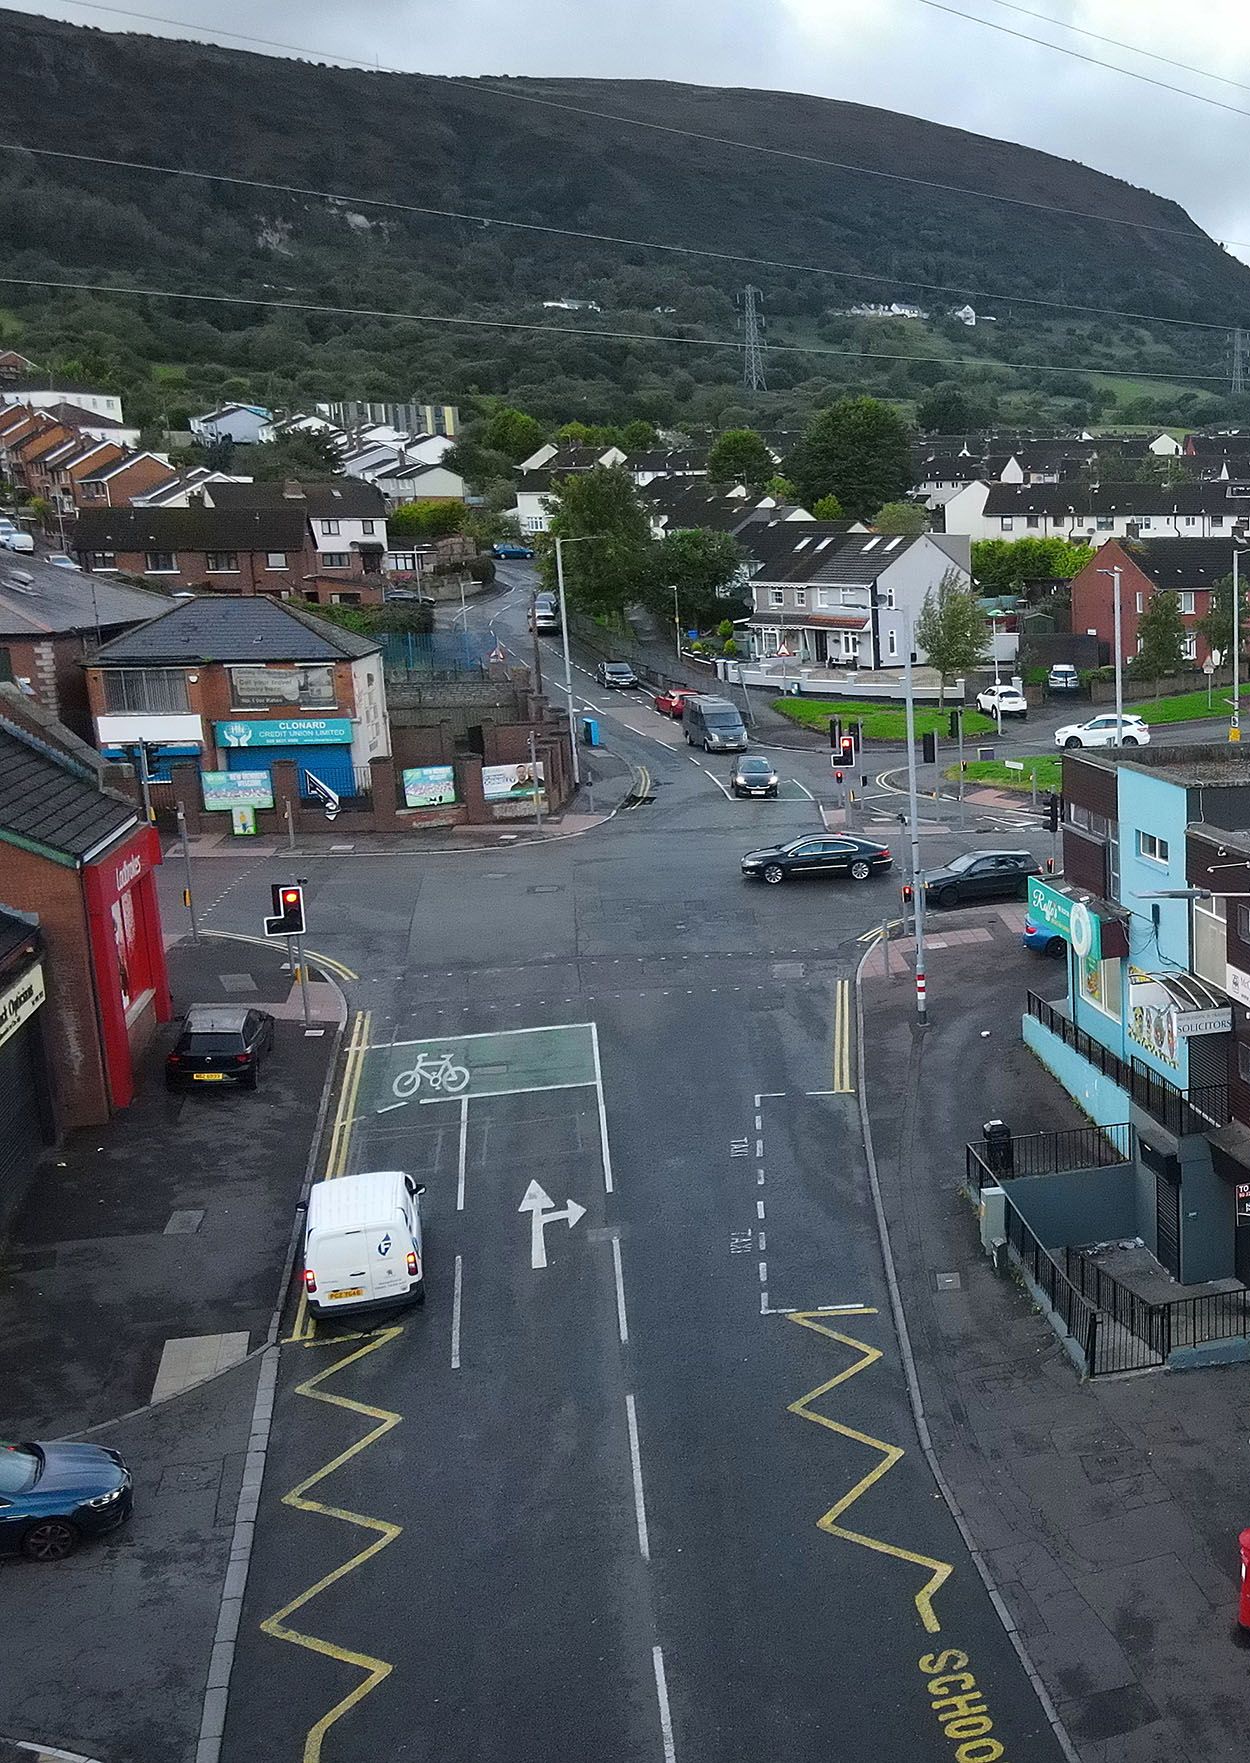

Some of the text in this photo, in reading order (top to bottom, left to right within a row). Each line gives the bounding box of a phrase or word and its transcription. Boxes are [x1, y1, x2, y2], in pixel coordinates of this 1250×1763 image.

[279, 721, 326, 730] CLONARD
[258, 730, 287, 738] CREDIT
[315, 729, 345, 737] LIMITED
[1177, 1019, 1232, 1034] SOLICITORS
[1239, 1184, 1249, 1193] TO
[918, 1649, 1009, 1763] SCHOO
